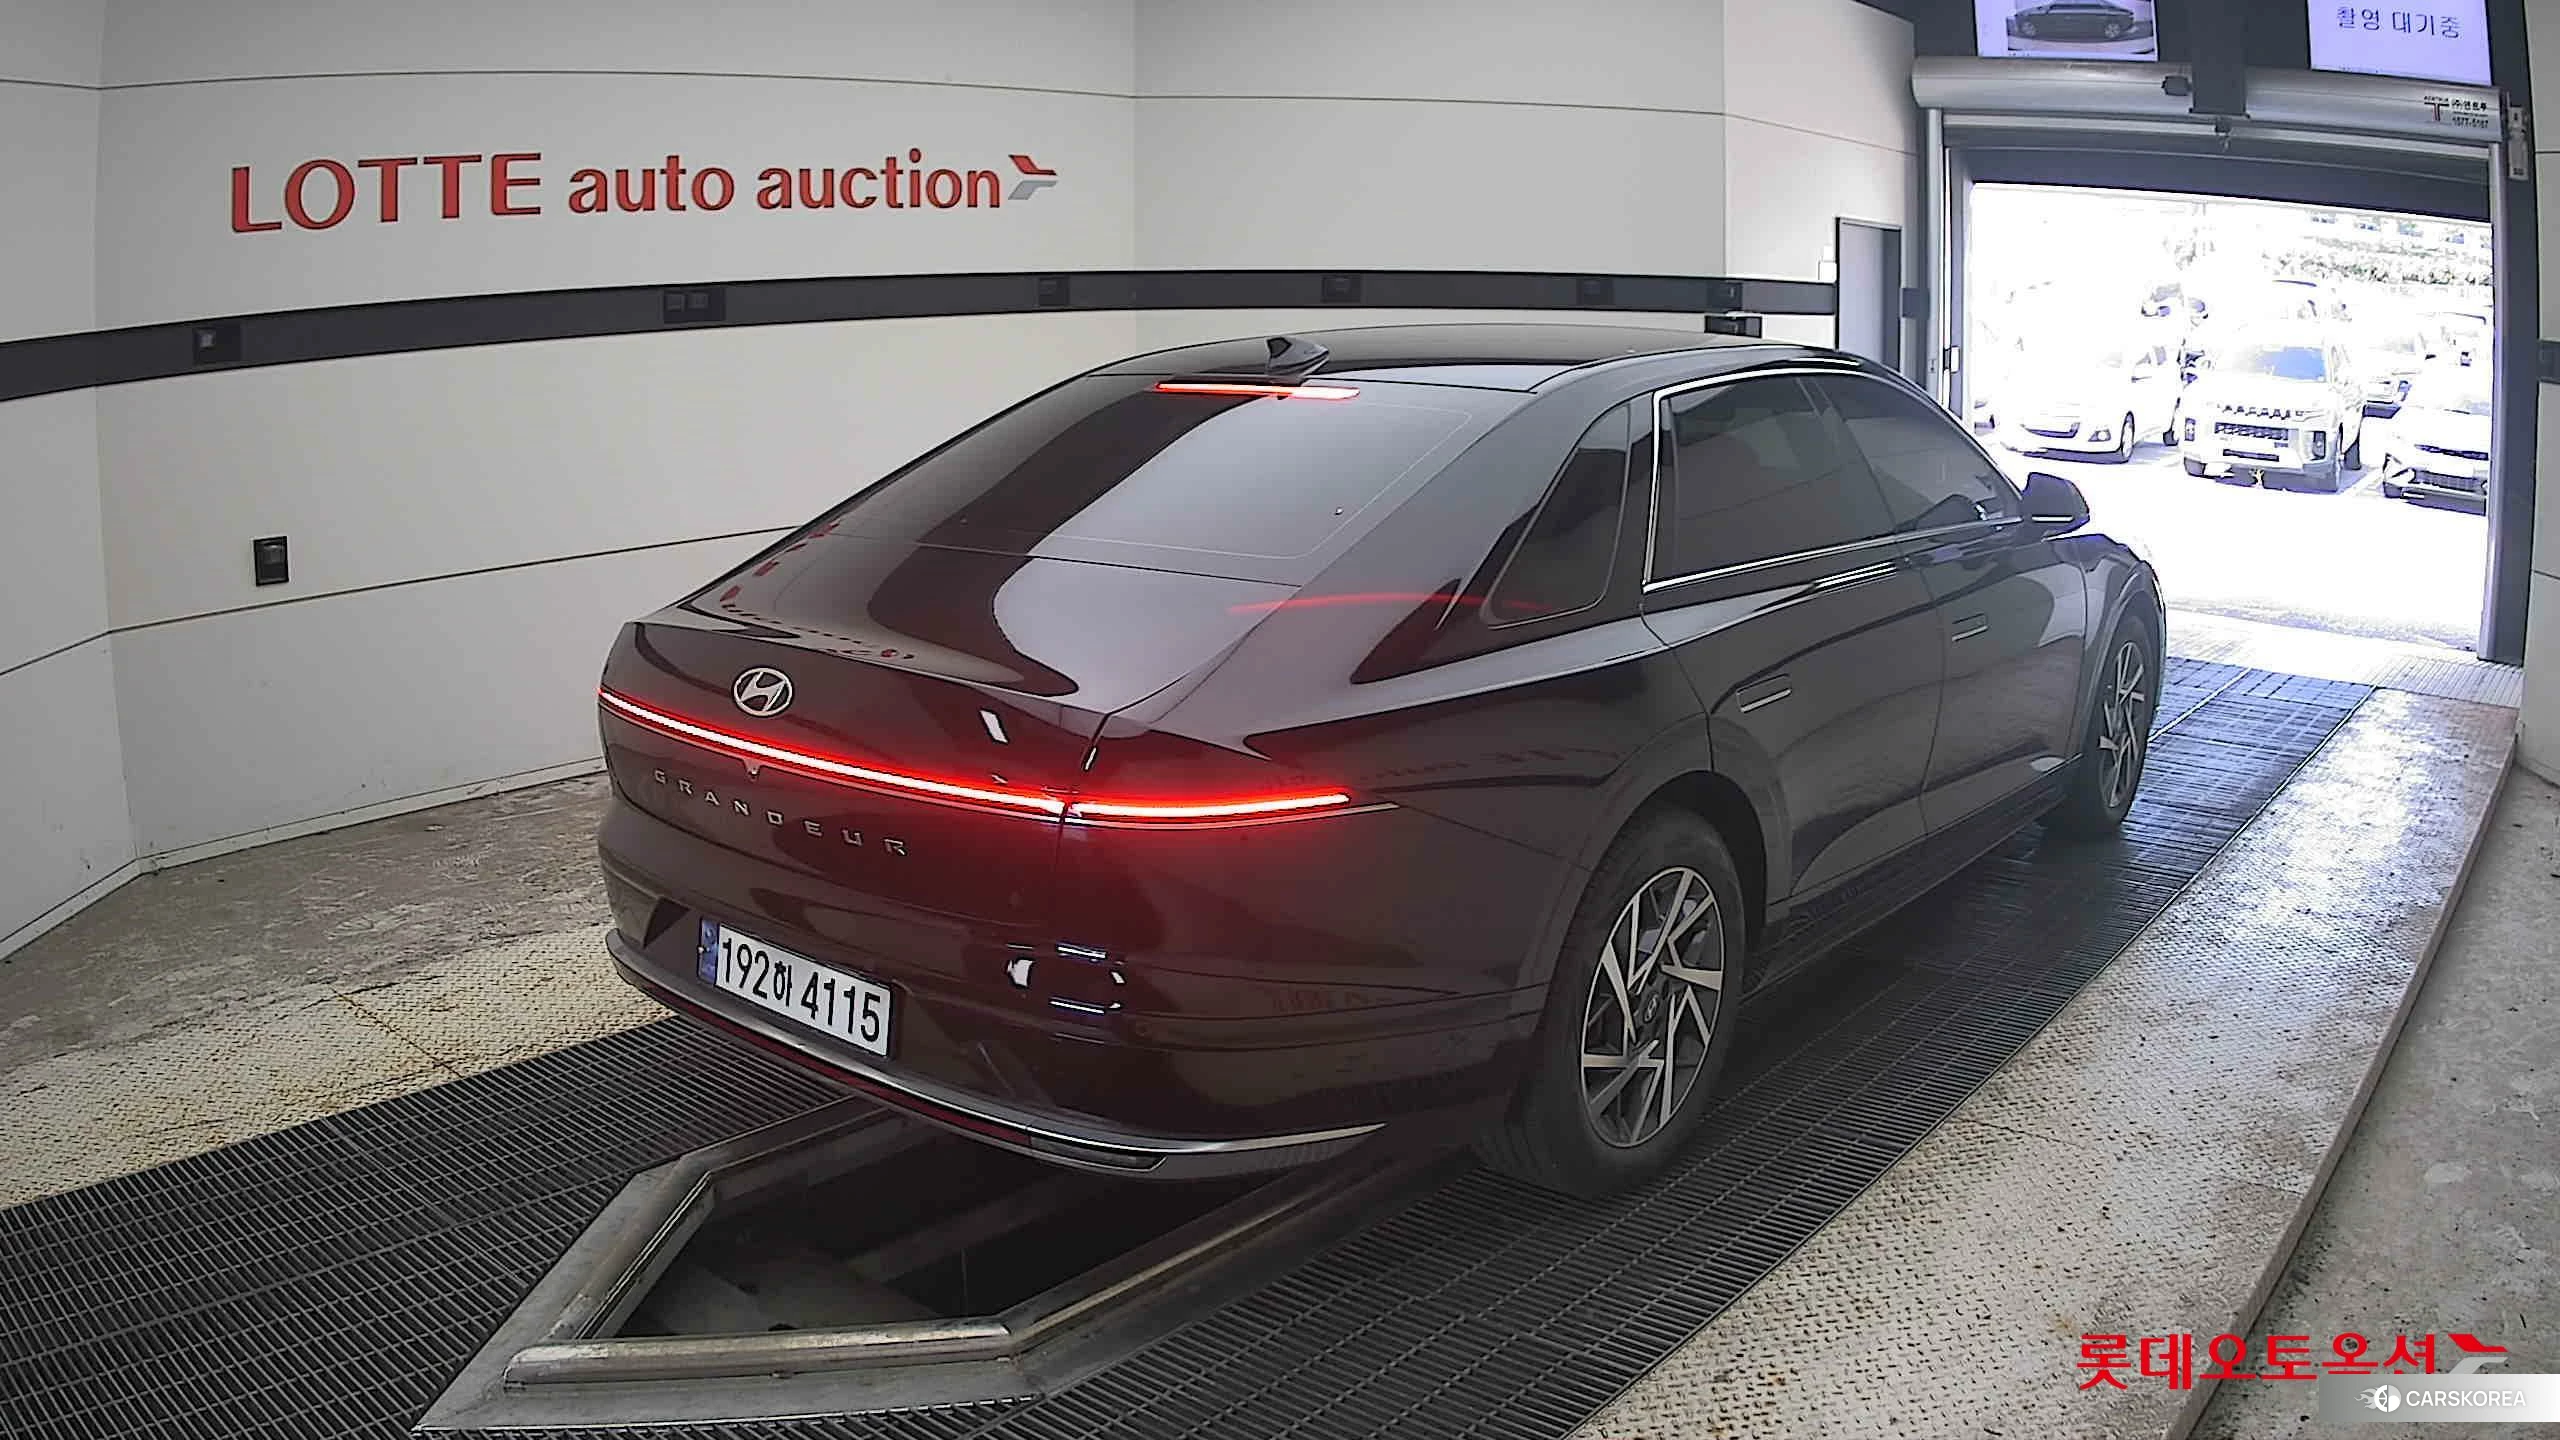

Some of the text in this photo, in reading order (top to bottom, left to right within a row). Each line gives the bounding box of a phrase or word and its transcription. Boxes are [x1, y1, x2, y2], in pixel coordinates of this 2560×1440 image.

[2337, 6, 2461, 39] 촬영 대기중
[233, 148, 1003, 232] LOTTE auto auction
[653, 768, 908, 856] GRANDEUR
[722, 937, 881, 1043] 192하 4115
